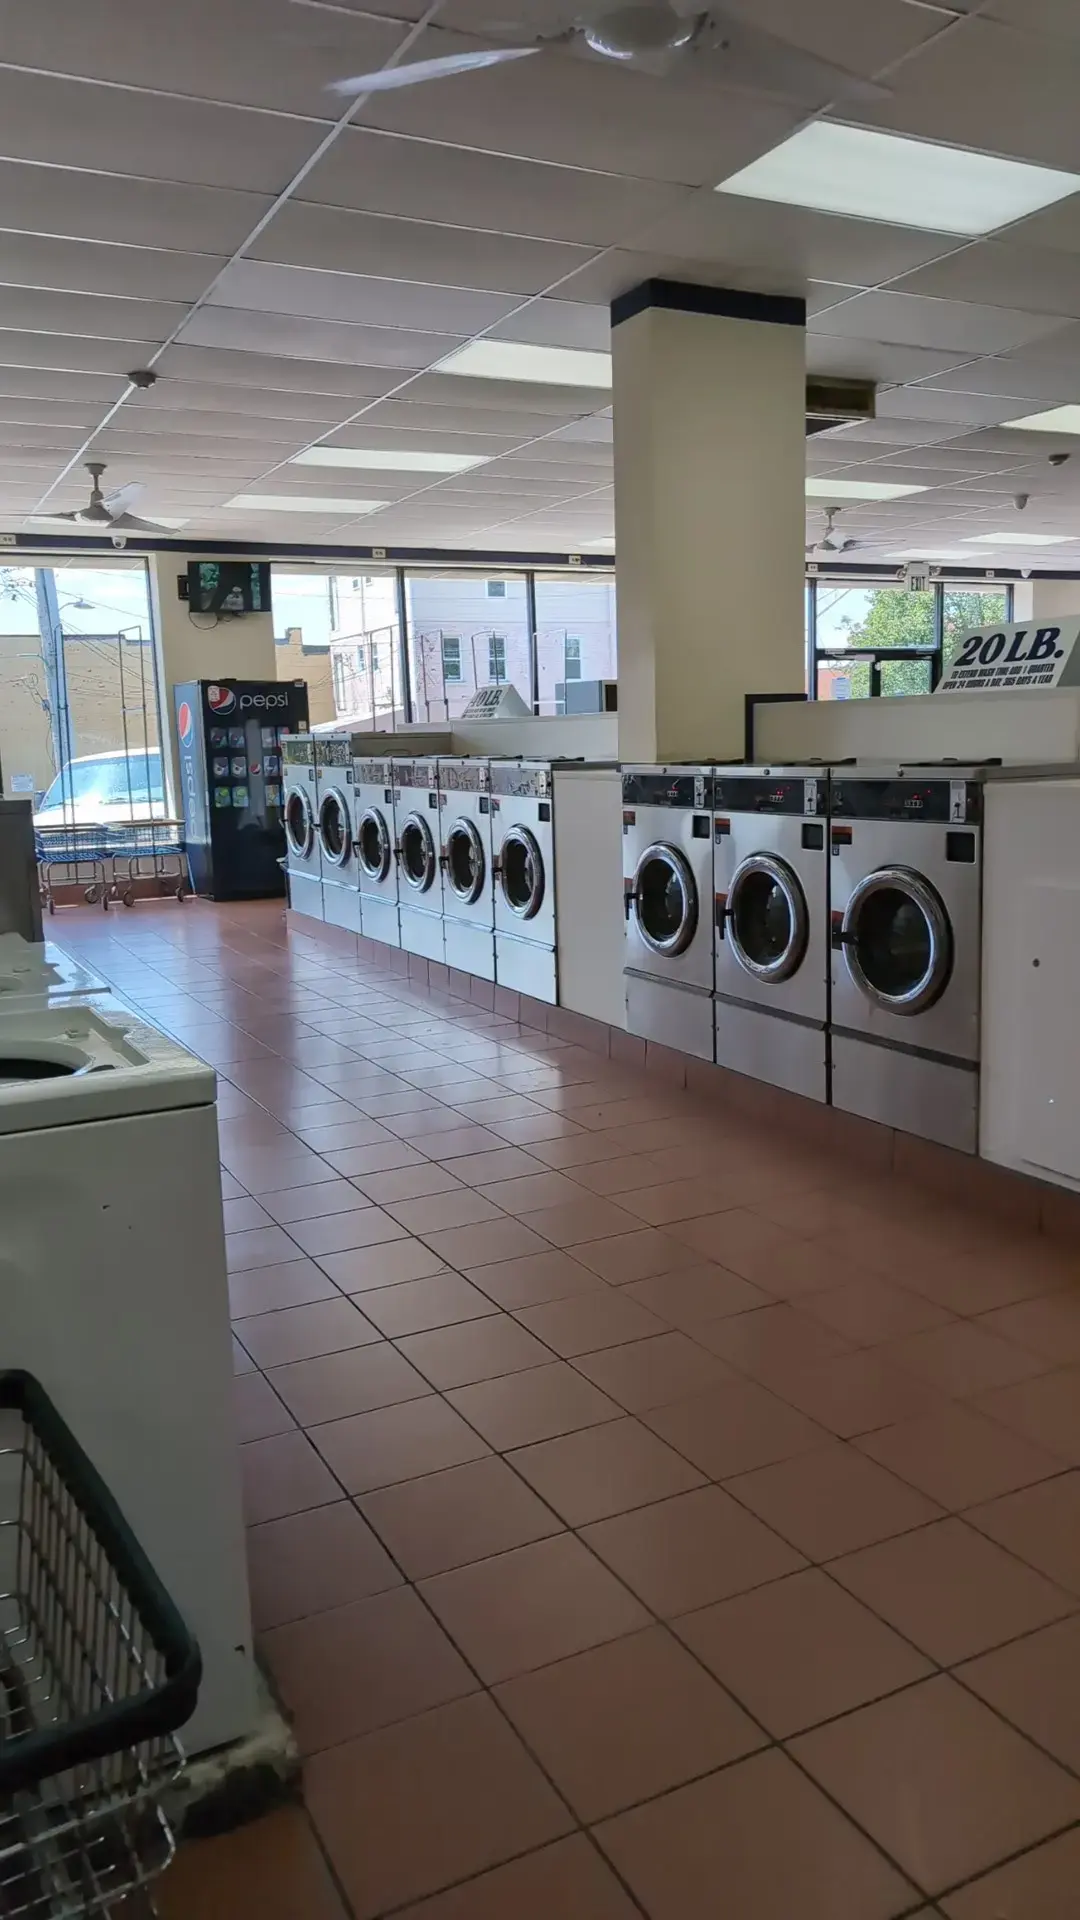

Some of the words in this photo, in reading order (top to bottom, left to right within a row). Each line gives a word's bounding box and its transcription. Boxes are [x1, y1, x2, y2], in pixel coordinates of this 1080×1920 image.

[954, 633, 1006, 666] 20
[1003, 627, 1064, 662] LB.
[942, 681, 957, 690] OPEN
[956, 680, 966, 689] 24
[965, 679, 985, 688] HOURS
[1015, 675, 1031, 685] DAYS
[1037, 674, 1054, 684] YEAR
[240, 692, 289, 710] pepsi
[184, 755, 197, 840] pepsi
